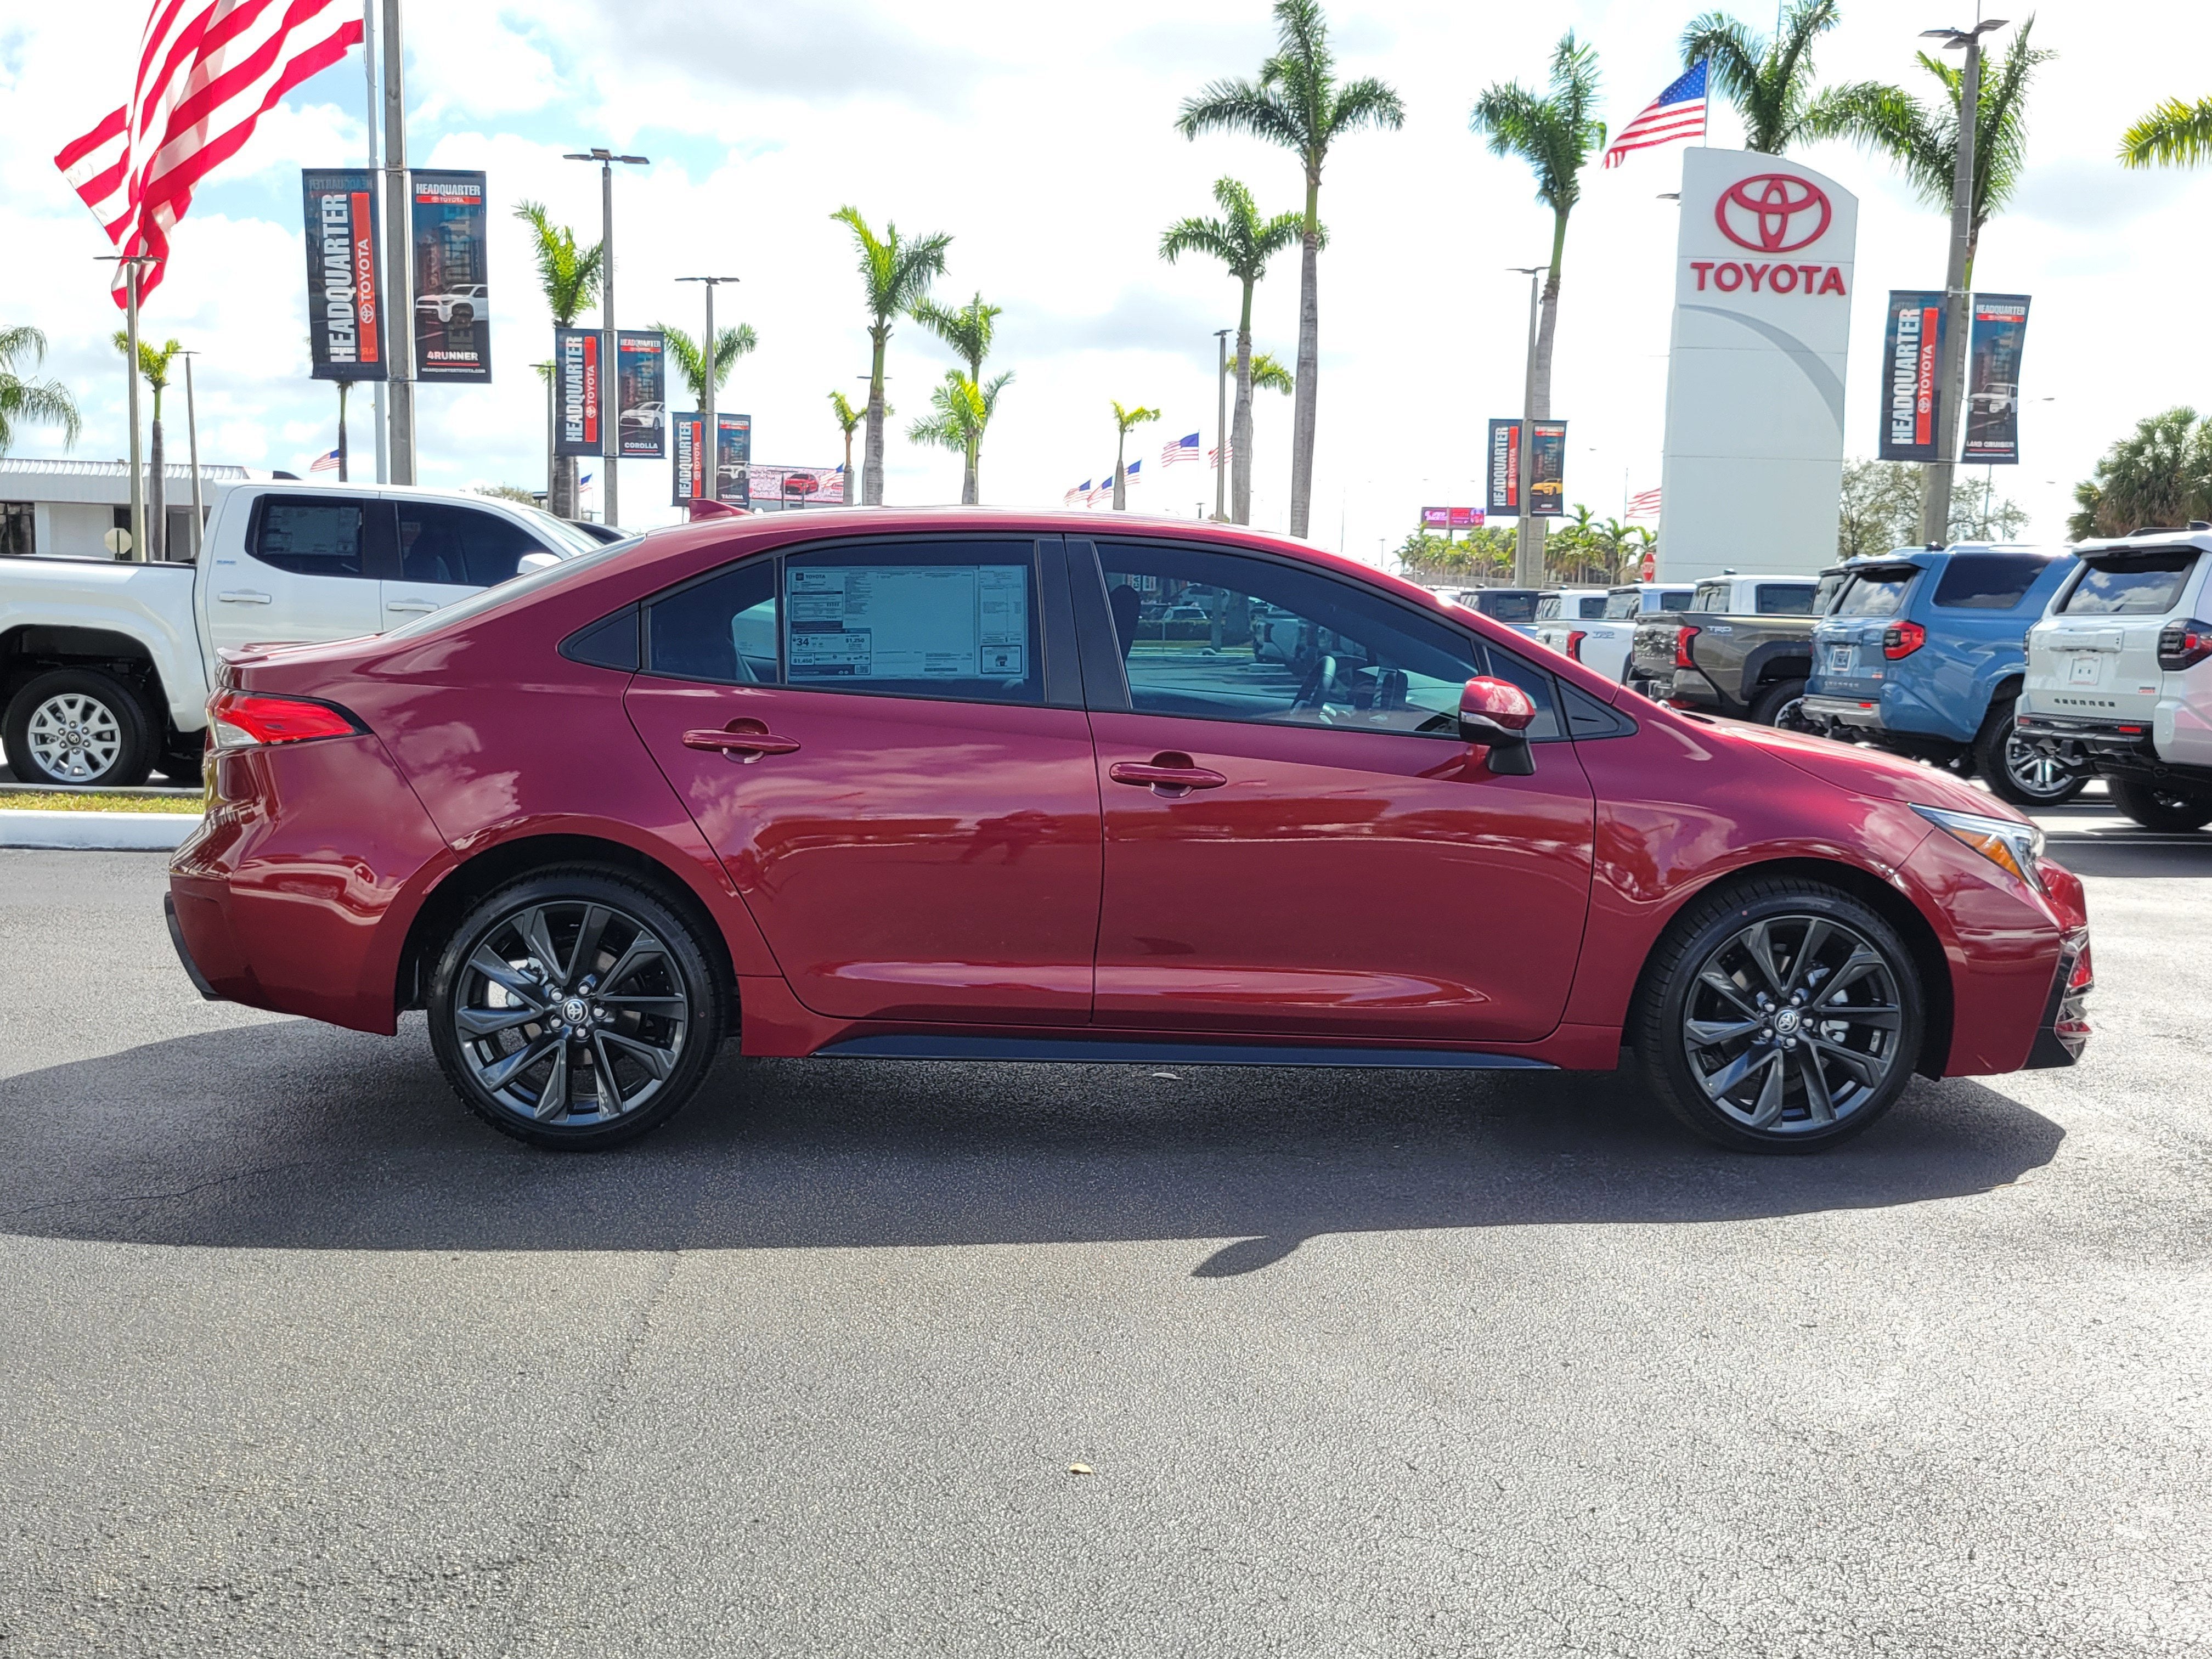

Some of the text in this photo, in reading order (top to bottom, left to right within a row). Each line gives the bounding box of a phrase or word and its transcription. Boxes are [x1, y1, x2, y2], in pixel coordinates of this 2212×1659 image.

[416, 183, 481, 196] HEADQUARTER
[321, 194, 357, 363] HEADQUARTER
[358, 239, 372, 302] TOYOTA
[1690, 262, 1846, 295] TOYOTA
[1976, 304, 2025, 315] HEADQUARTER
[427, 351, 478, 361] 4RUNNER
[1891, 308, 1920, 445] HEADQUARTER
[1920, 344, 1934, 397] TOYOTA
[566, 336, 585, 442] HEADQUARTER
[586, 365, 595, 404] TOYOTA
[679, 421, 692, 498] HEADQUARTER
[1493, 427, 1508, 506] HEADQUARTER
[796, 637, 809, 646] 34
[2054, 698, 2115, 707] 4RUNNER
